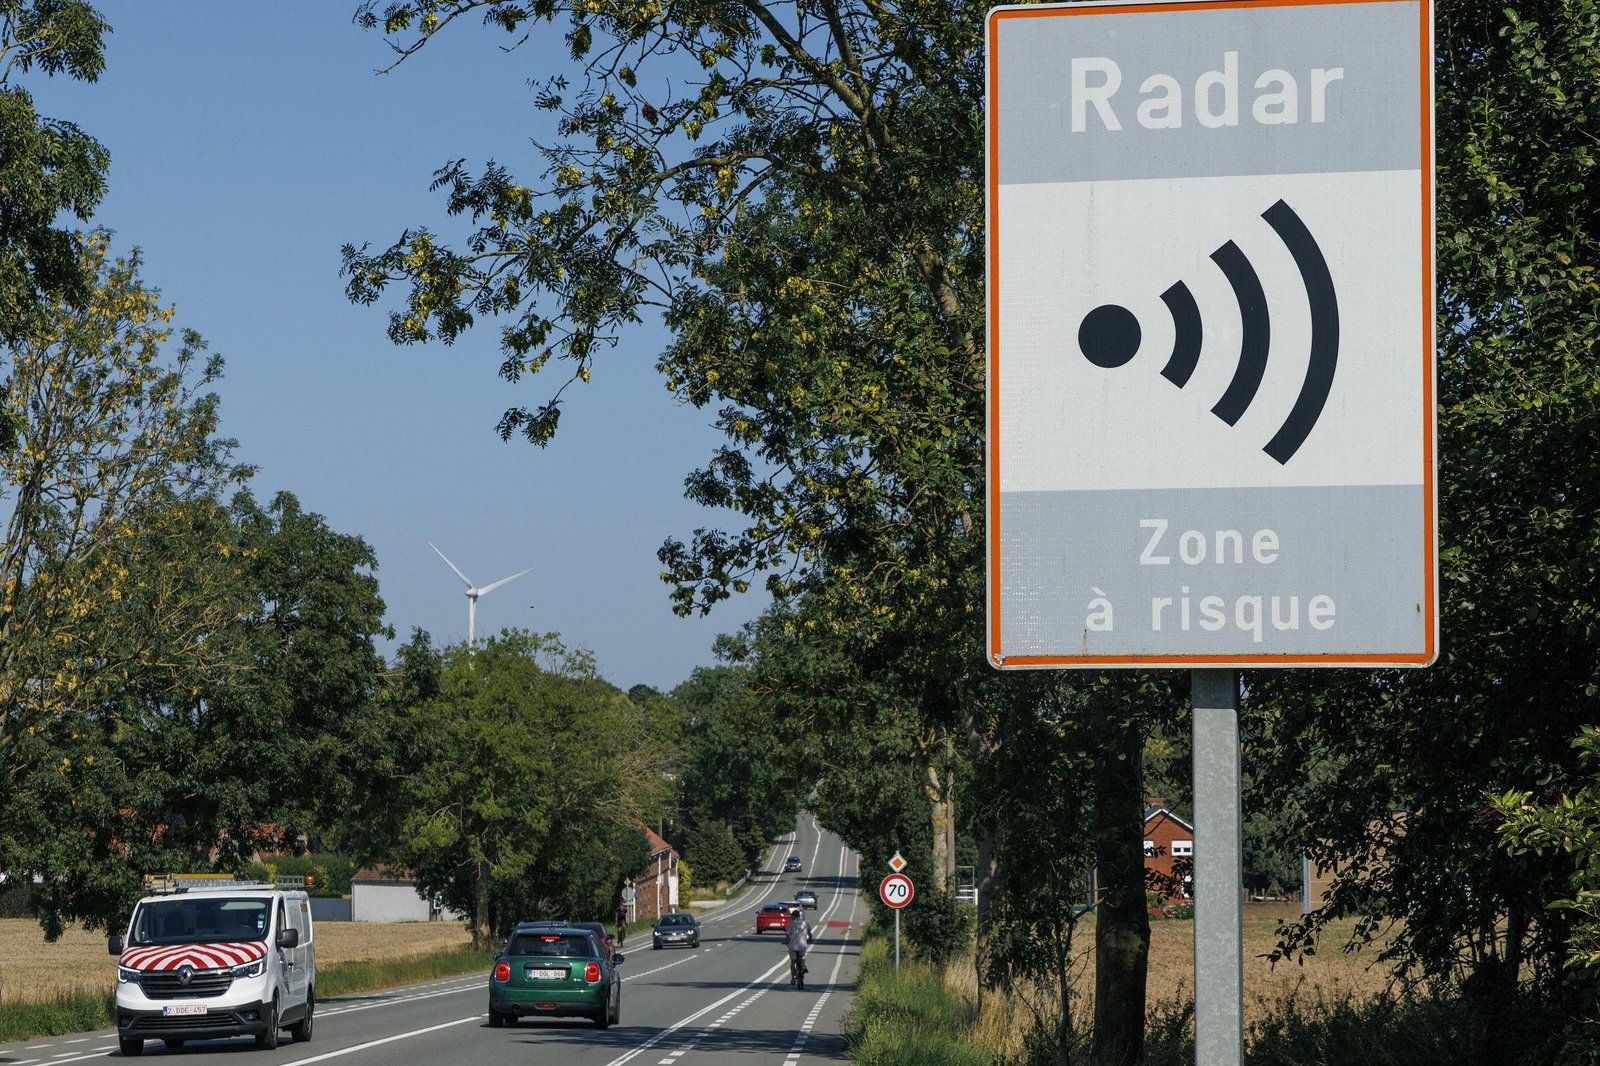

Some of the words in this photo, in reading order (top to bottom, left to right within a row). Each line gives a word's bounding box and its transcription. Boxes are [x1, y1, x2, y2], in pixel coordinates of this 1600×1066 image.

[1070, 51, 1344, 132] Radar
[1139, 518, 1280, 565] Zone
[1085, 586, 1114, 632] à
[1151, 586, 1336, 643] risque
[888, 884, 907, 897] 70
